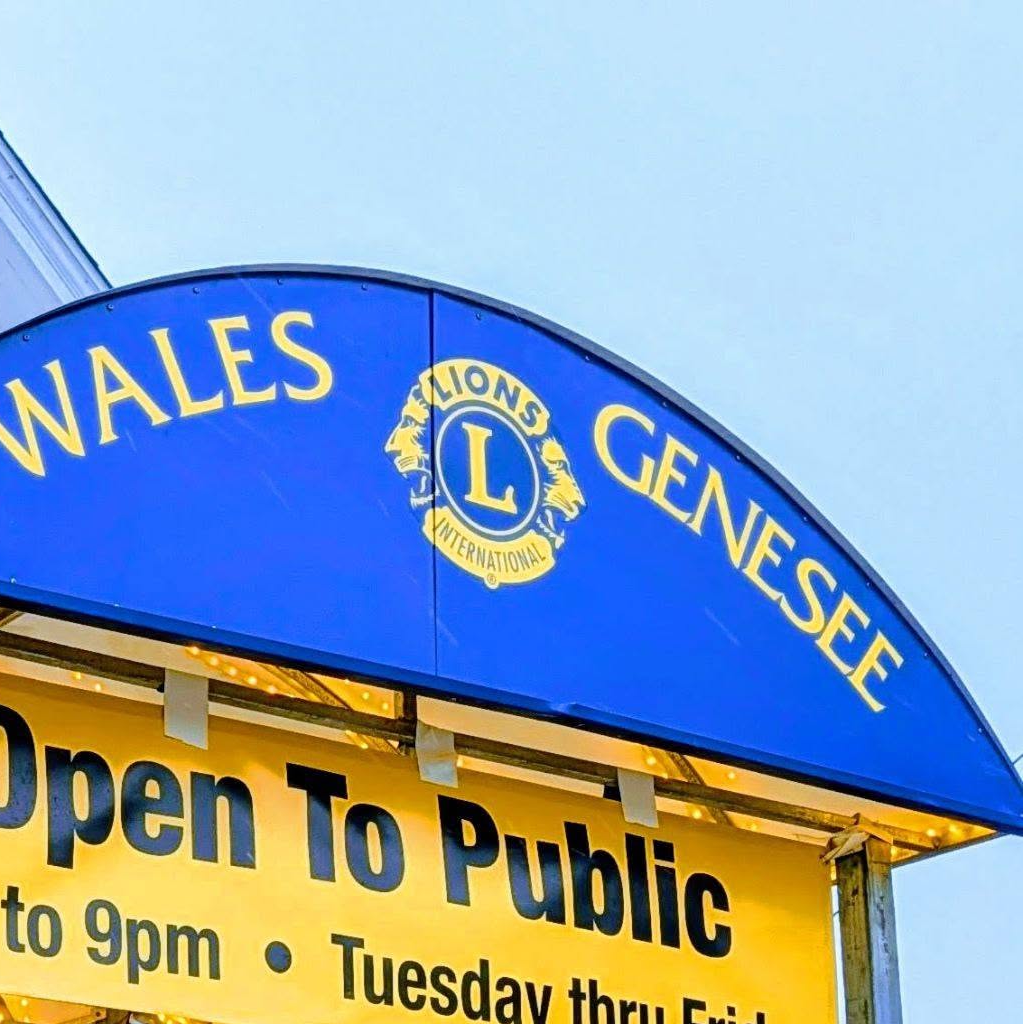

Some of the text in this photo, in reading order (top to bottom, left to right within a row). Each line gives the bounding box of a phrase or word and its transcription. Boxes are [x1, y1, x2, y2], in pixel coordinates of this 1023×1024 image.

[429, 365, 542, 428] LIONS
[462, 421, 518, 514] L
[432, 517, 546, 573] INTERNATIONAL
[593, 404, 904, 712] GENESEE
[286, 762, 405, 892] To
[437, 794, 732, 958] Public
[0, 885, 63, 958] to
[84, 899, 221, 985] 9pm
